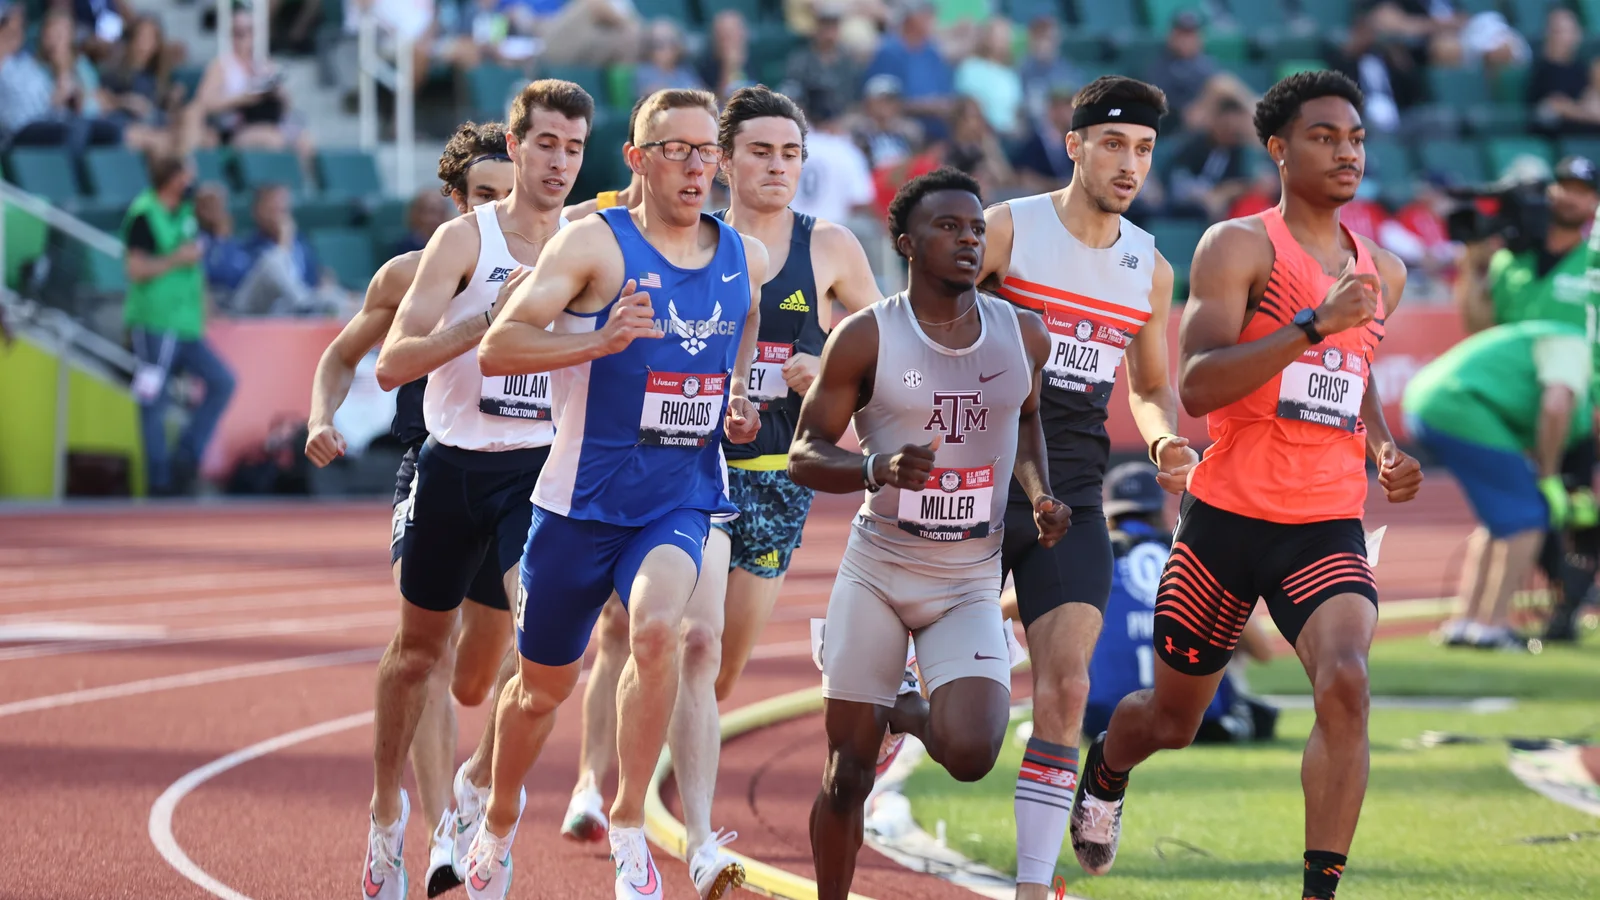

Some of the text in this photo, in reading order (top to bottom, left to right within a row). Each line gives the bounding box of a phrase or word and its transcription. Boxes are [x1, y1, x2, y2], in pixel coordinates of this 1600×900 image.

[779, 302, 810, 313] adidas
[653, 319, 736, 335] AIR FORCE
[1054, 342, 1099, 373] PIAZZA
[503, 375, 548, 398] DOLAN
[748, 369, 766, 391] EY
[903, 369, 922, 388] SEC
[1308, 373, 1349, 403] CRISP
[660, 401, 711, 426] RHOADS
[920, 495, 975, 520] MILLER
